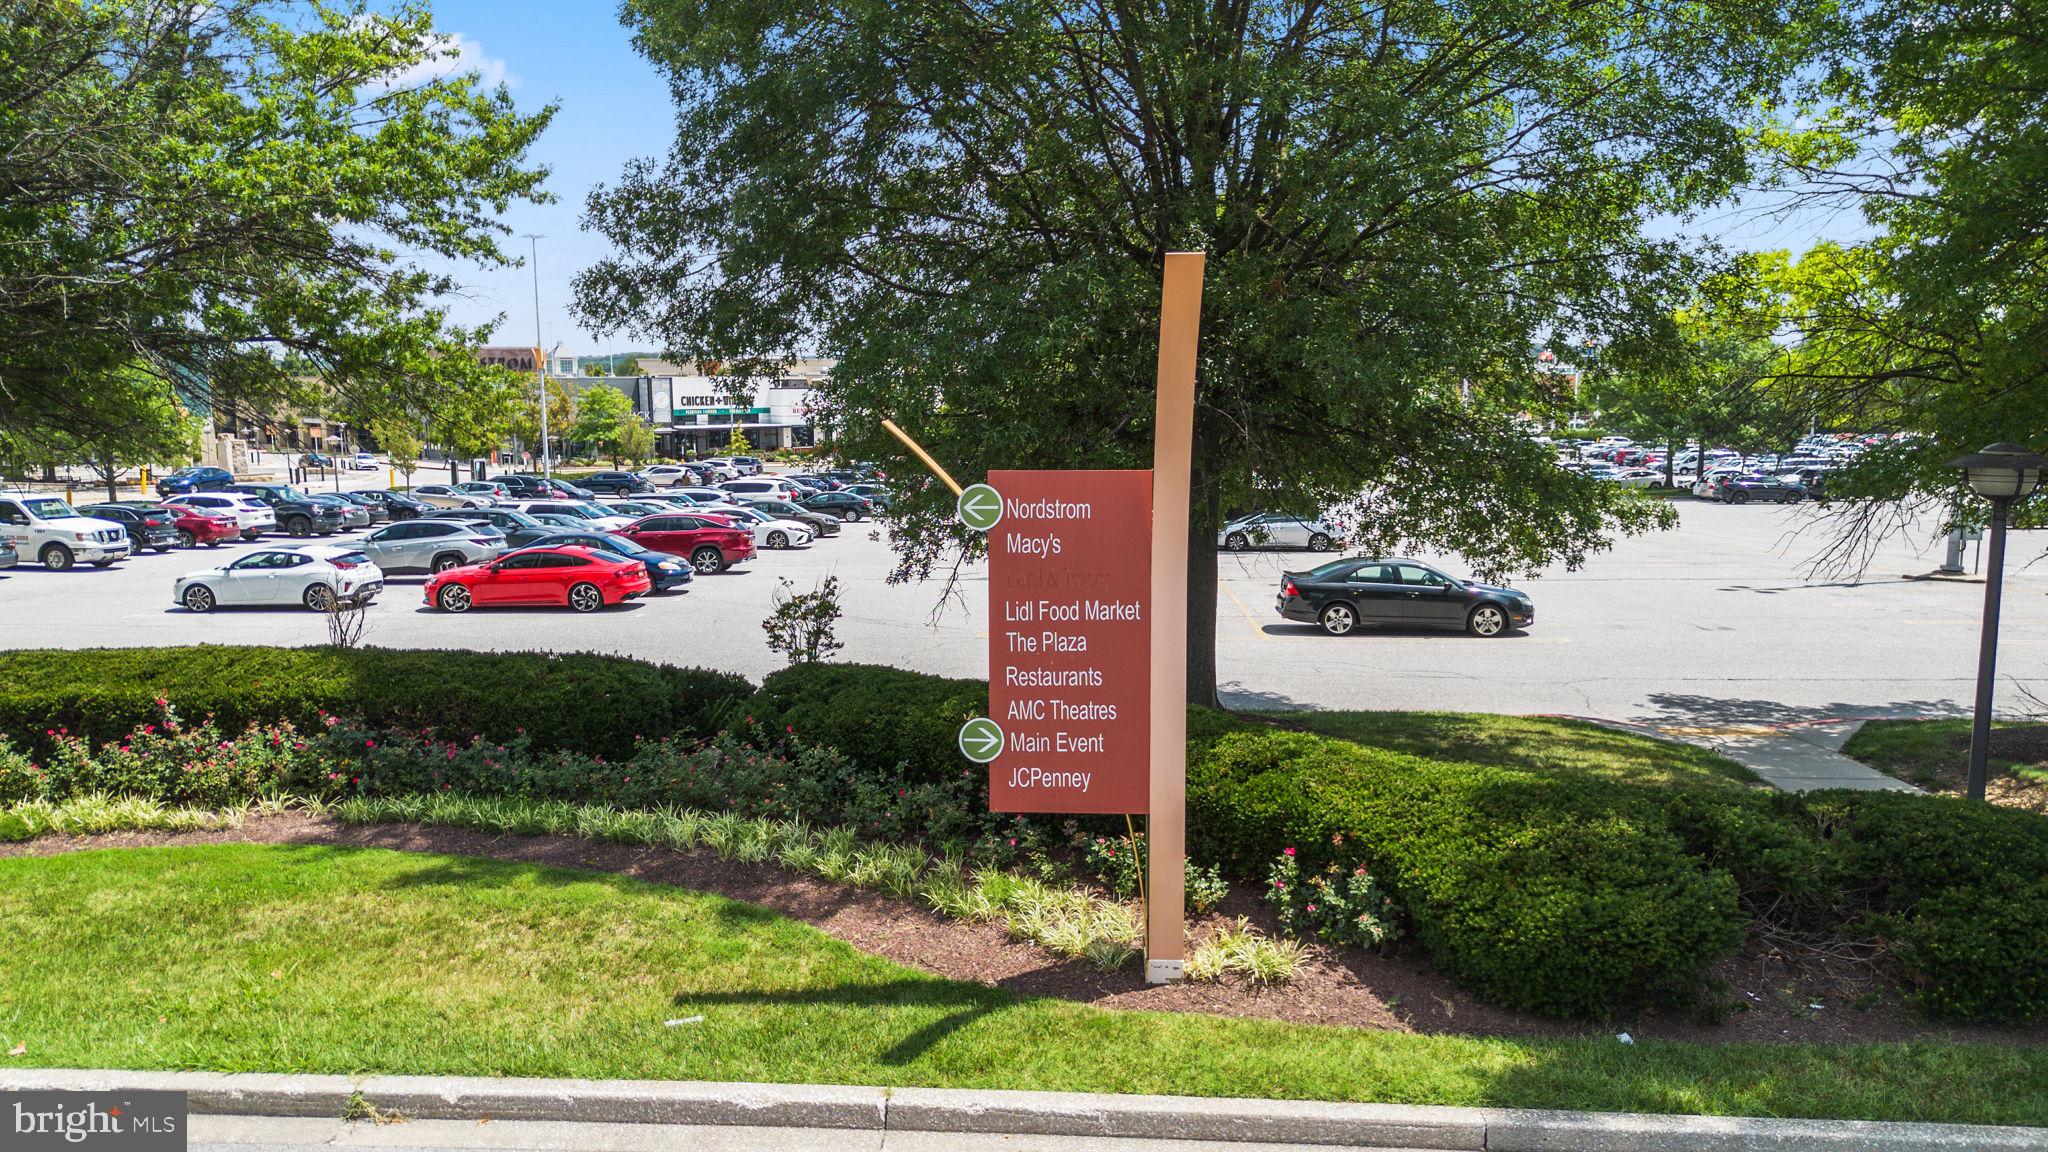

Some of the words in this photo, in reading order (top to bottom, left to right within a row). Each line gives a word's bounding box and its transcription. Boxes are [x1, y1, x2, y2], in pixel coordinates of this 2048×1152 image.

[681, 396, 715, 407] CHICKEN
[1006, 497, 1091, 520] Nordstrom
[1006, 533, 1061, 559] Macy's
[1005, 600, 1033, 622] Lidl
[1039, 600, 1079, 621] Food
[1085, 600, 1141, 621] Market
[1005, 632, 1039, 652] The
[1042, 632, 1087, 652] Plaza
[1006, 665, 1103, 687] Restaurants
[1007, 699, 1046, 720] AMC
[1050, 699, 1117, 721] Theatres
[1011, 732, 1051, 752] Main
[1056, 732, 1104, 752] Event
[1008, 767, 1091, 792] JCPenney
